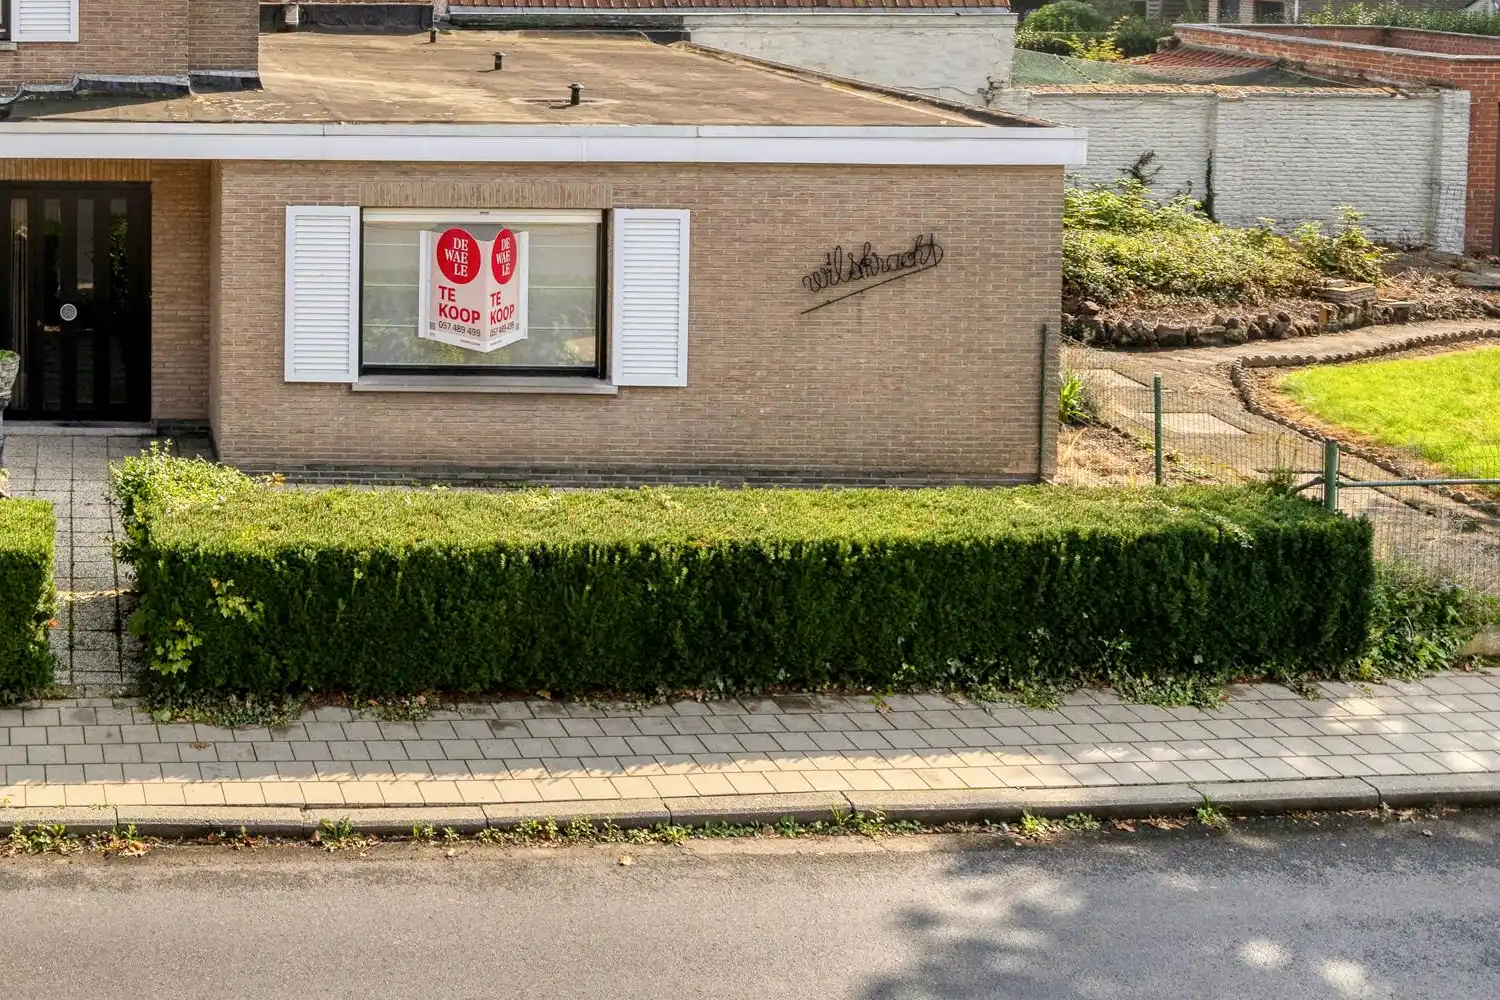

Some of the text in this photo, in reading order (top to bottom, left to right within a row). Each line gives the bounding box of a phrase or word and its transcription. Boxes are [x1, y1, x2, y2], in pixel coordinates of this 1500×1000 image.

[453, 237, 469, 251] DE
[501, 237, 511, 251] DE
[444, 248, 469, 265] WAE
[496, 250, 511, 265] WAE
[453, 264, 468, 277] LE
[501, 262, 511, 277] LE
[438, 285, 456, 302] TE
[490, 291, 501, 307] TE
[438, 302, 481, 324] KOOP
[490, 304, 515, 326] KOOP
[438, 320, 451, 330] 057
[467, 327, 481, 337] 499
